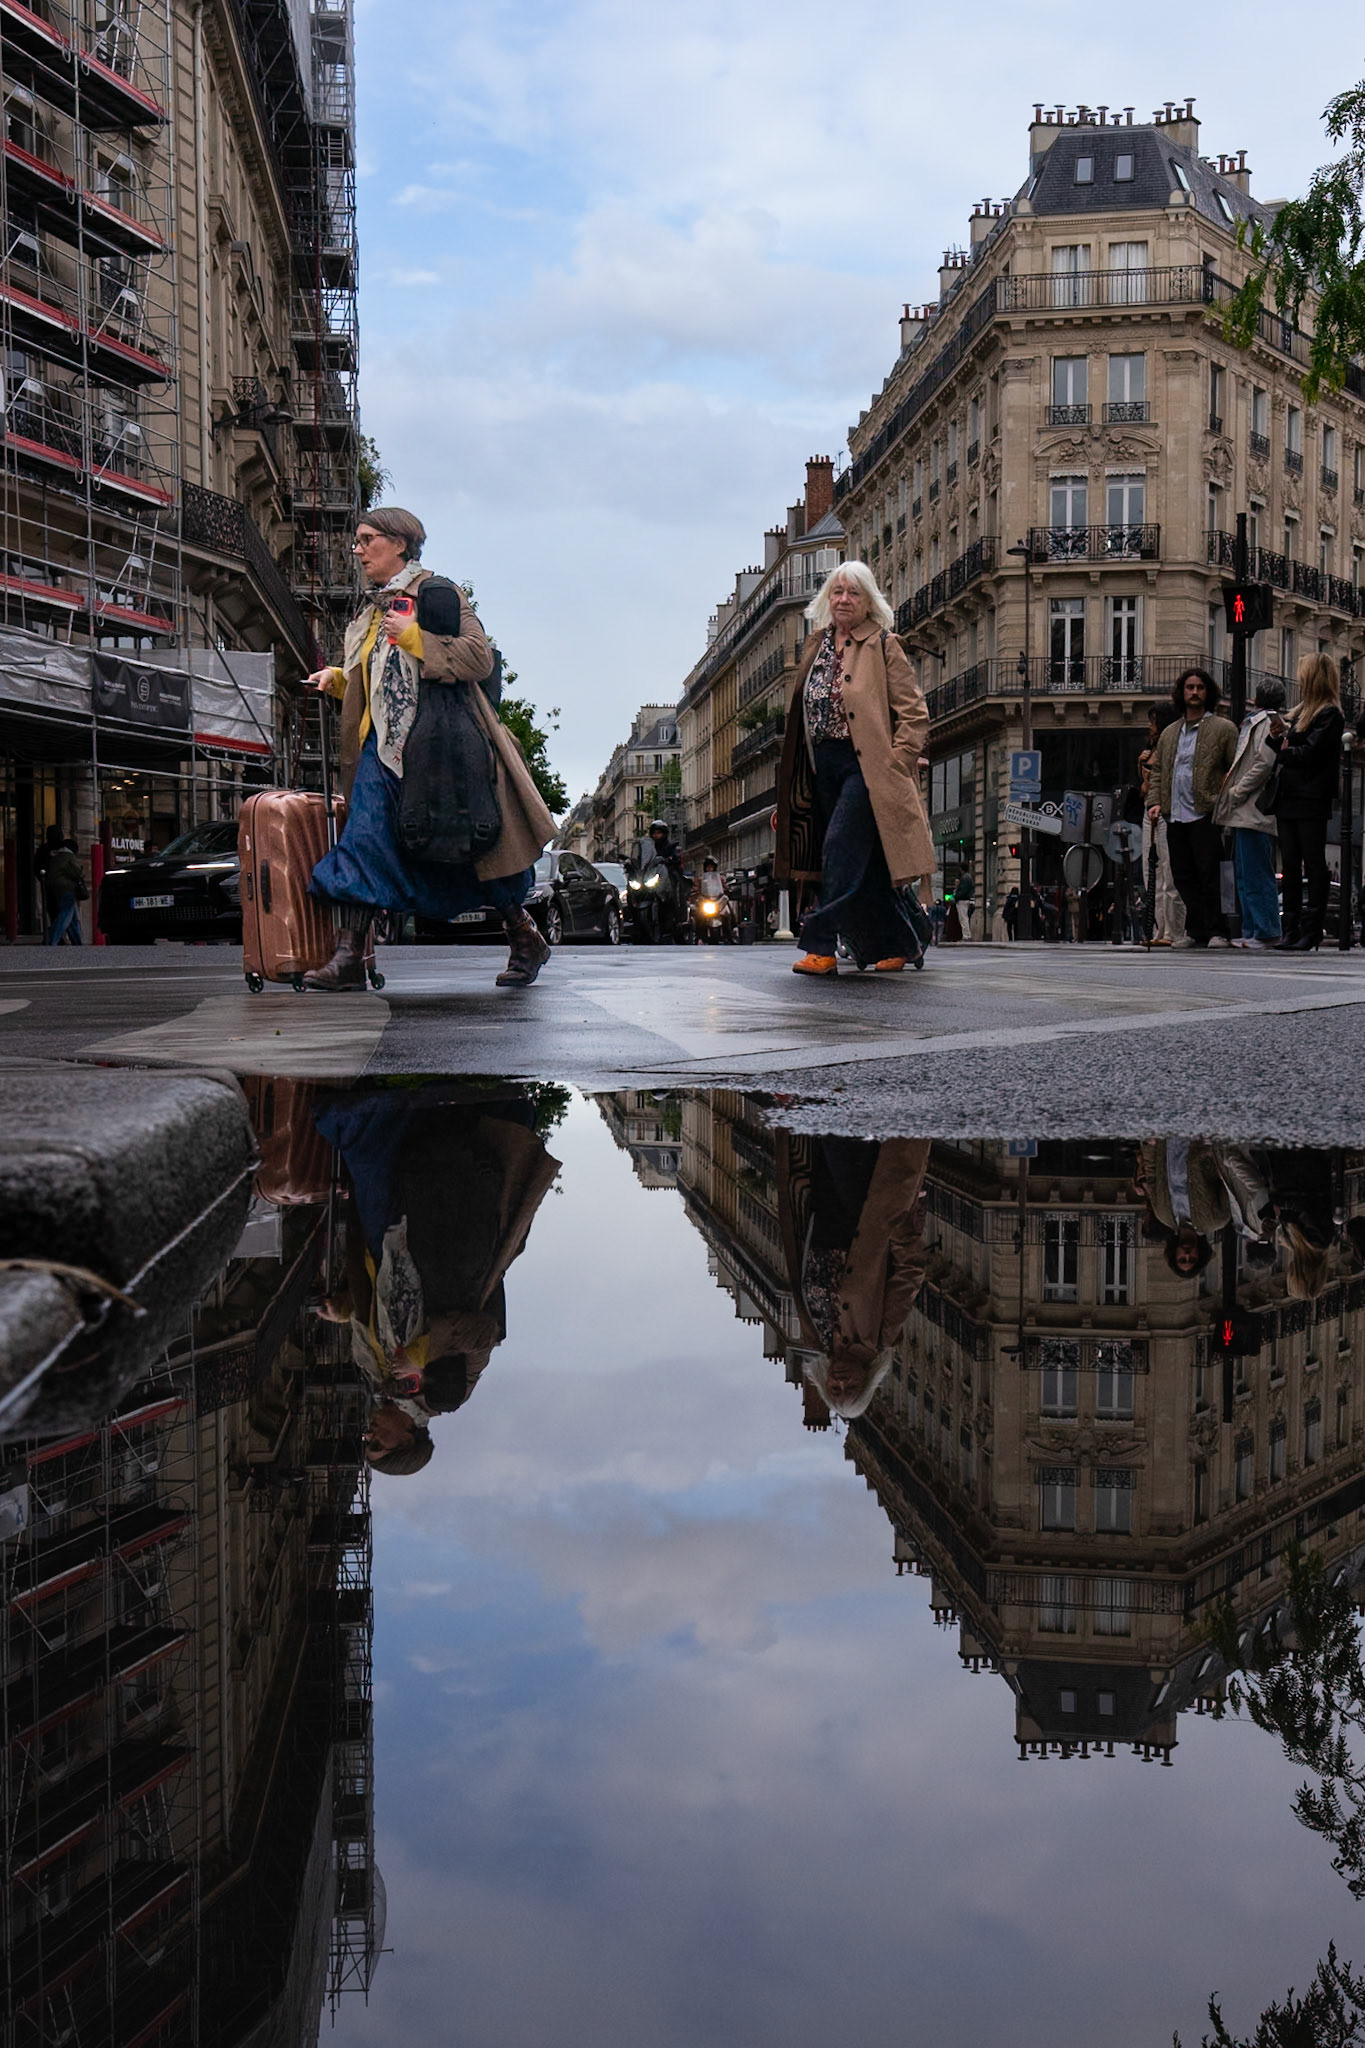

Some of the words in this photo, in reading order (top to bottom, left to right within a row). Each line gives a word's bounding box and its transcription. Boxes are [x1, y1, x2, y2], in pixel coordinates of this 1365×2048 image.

[1018, 757, 1032, 776] P
[1045, 804, 1054, 814] B
[1008, 814, 1040, 826] STALINGRAD
